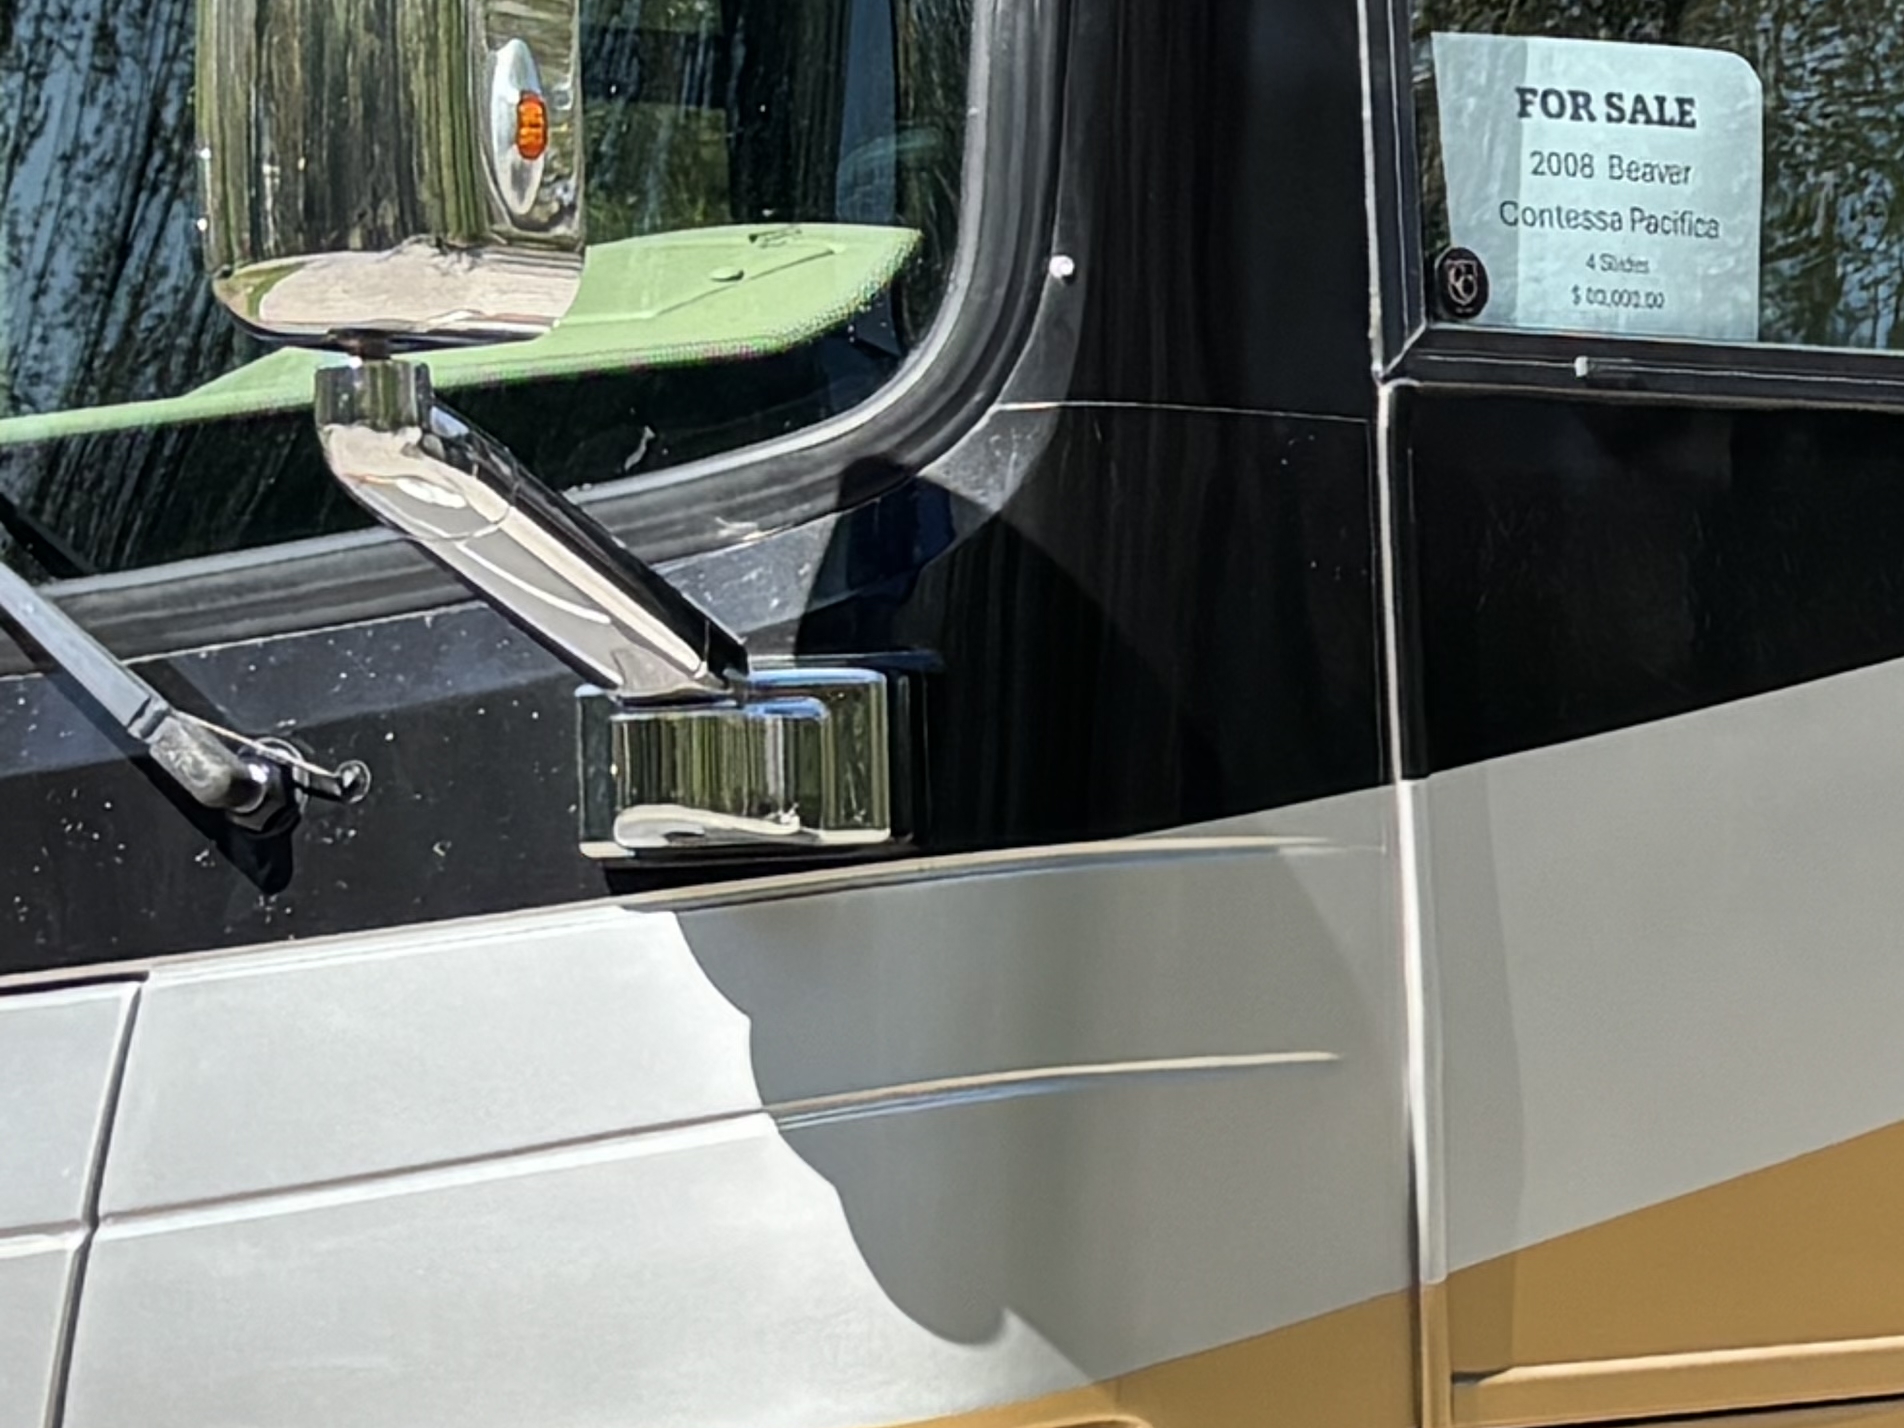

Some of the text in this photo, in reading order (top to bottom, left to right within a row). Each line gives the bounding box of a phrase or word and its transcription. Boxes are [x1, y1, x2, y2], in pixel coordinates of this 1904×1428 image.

[1515, 87, 1697, 128] FOR SALE
[1530, 150, 1692, 185] 2008 Beaver
[1499, 200, 1720, 239] Contessa Pacifica
